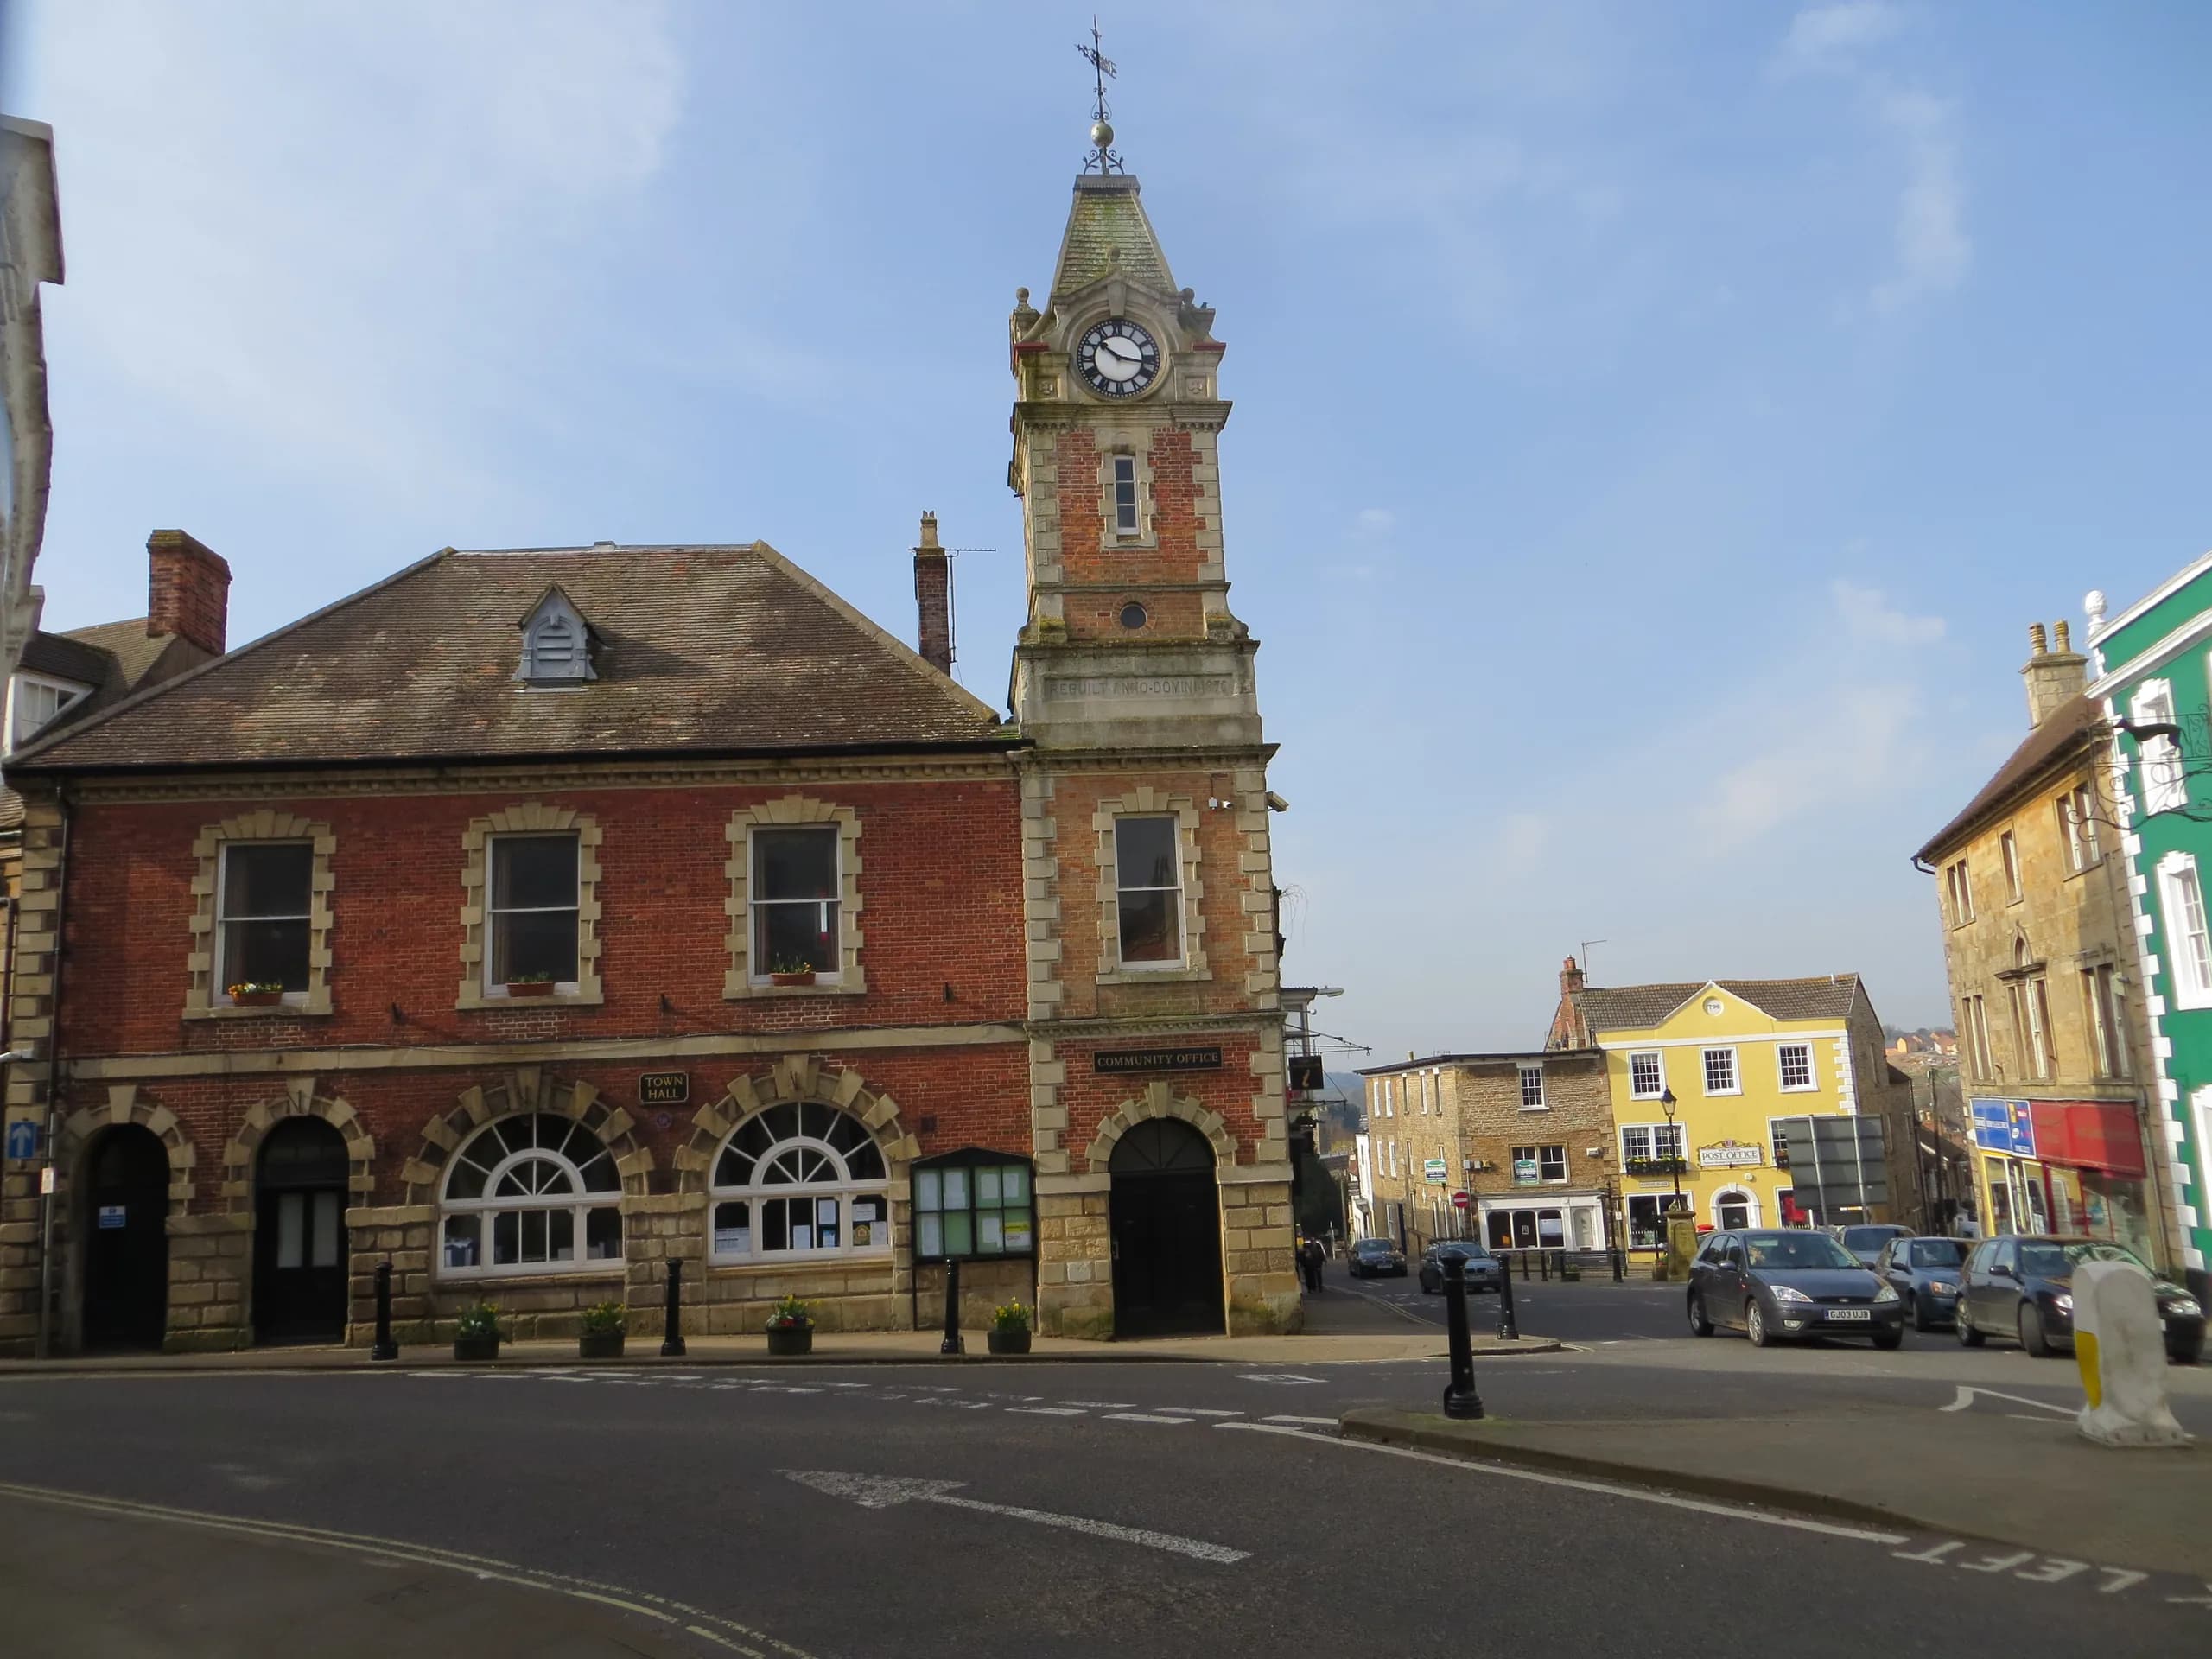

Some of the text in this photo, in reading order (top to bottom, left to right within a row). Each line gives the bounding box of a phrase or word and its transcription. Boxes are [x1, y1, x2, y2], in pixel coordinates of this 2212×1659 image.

[1049, 682, 1107, 696] REBUILT
[1097, 1052, 1218, 1066] COMMUNITY OFFICE
[645, 1076, 683, 1088] TOWN
[648, 1088, 680, 1100] HALL
[1701, 1151, 1724, 1160] POST
[1726, 1149, 1758, 1159] OFFICE
[1891, 1541, 2150, 1593] LEFT
